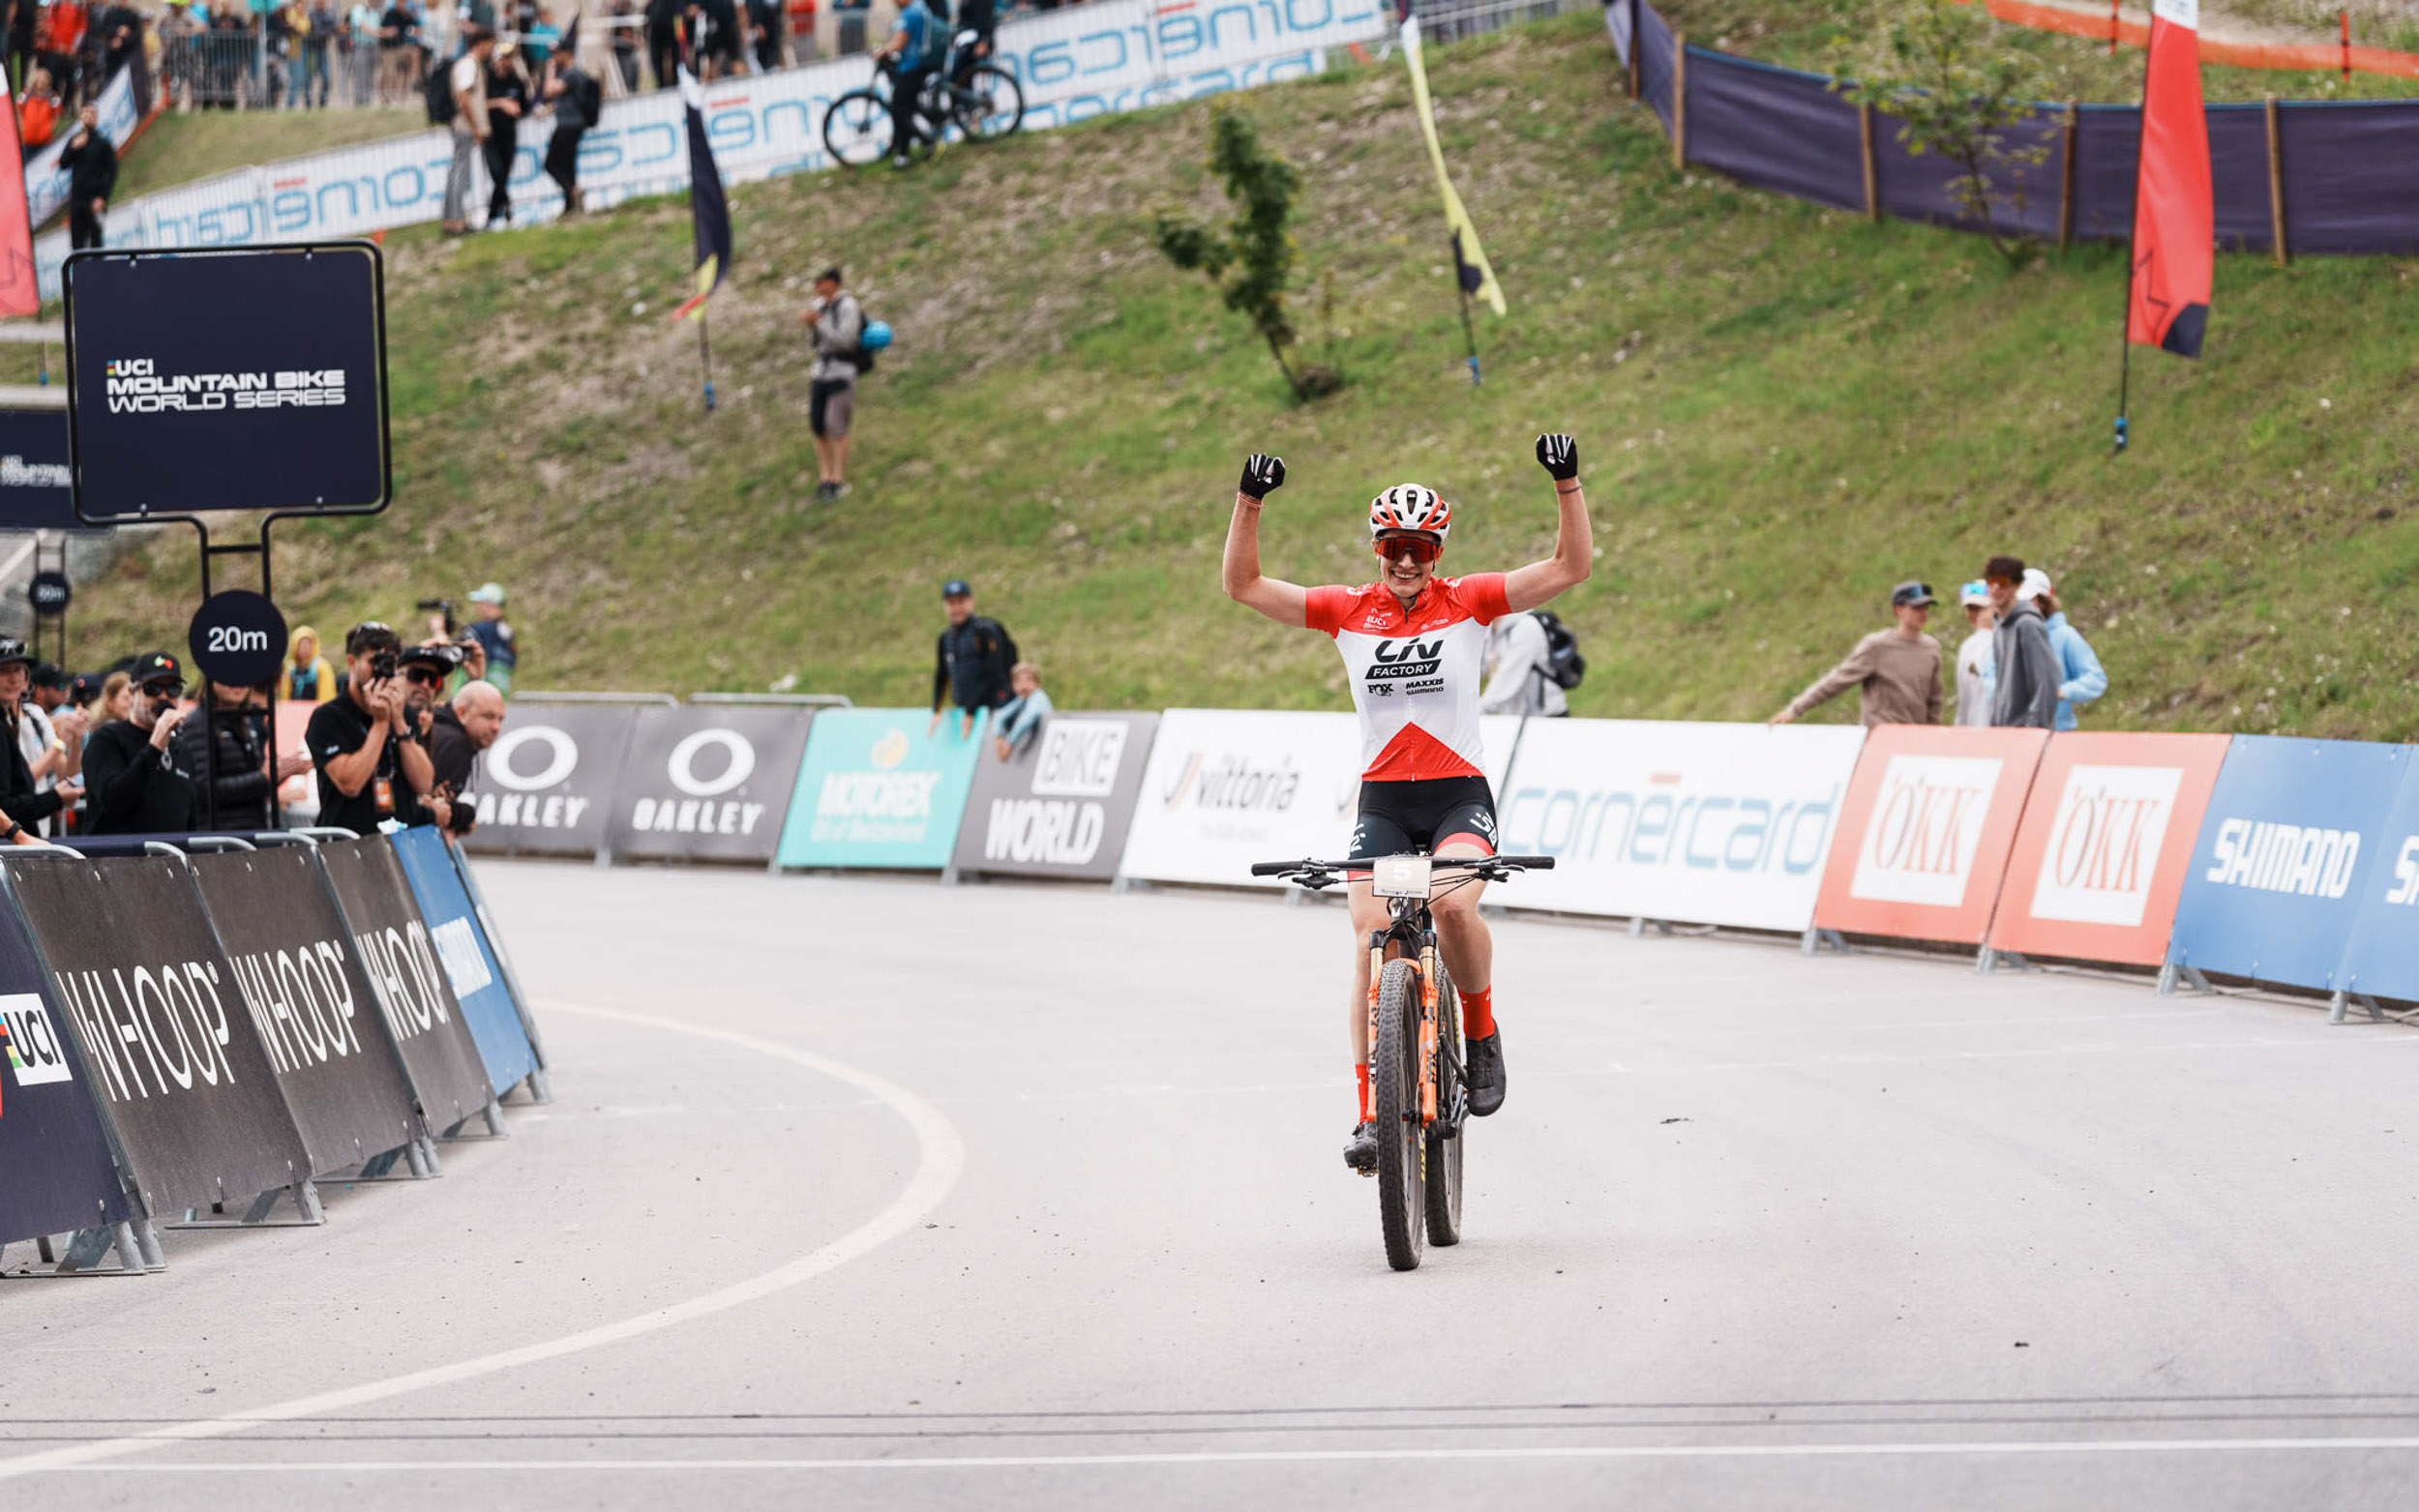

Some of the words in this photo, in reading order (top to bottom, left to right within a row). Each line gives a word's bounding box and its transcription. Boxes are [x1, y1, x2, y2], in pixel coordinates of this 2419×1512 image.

[107, 372, 267, 395] MOUNTAIN
[275, 370, 345, 389] BIKE
[114, 359, 154, 376] UCI
[108, 393, 226, 413] WORLD
[233, 388, 346, 409] SERIES
[208, 626, 268, 652] 20m
[1374, 664, 1433, 676] FACTORY
[1405, 678, 1444, 689] MAXXIS
[1043, 730, 1119, 785] BIKE
[632, 797, 764, 836] OAKLEY
[984, 798, 1105, 866] WORLD
[2205, 816, 2362, 900] SHIMANO
[228, 938, 362, 1075] WHOOP
[2, 1010, 61, 1068] UCI
[55, 961, 235, 1103] WHOOP
